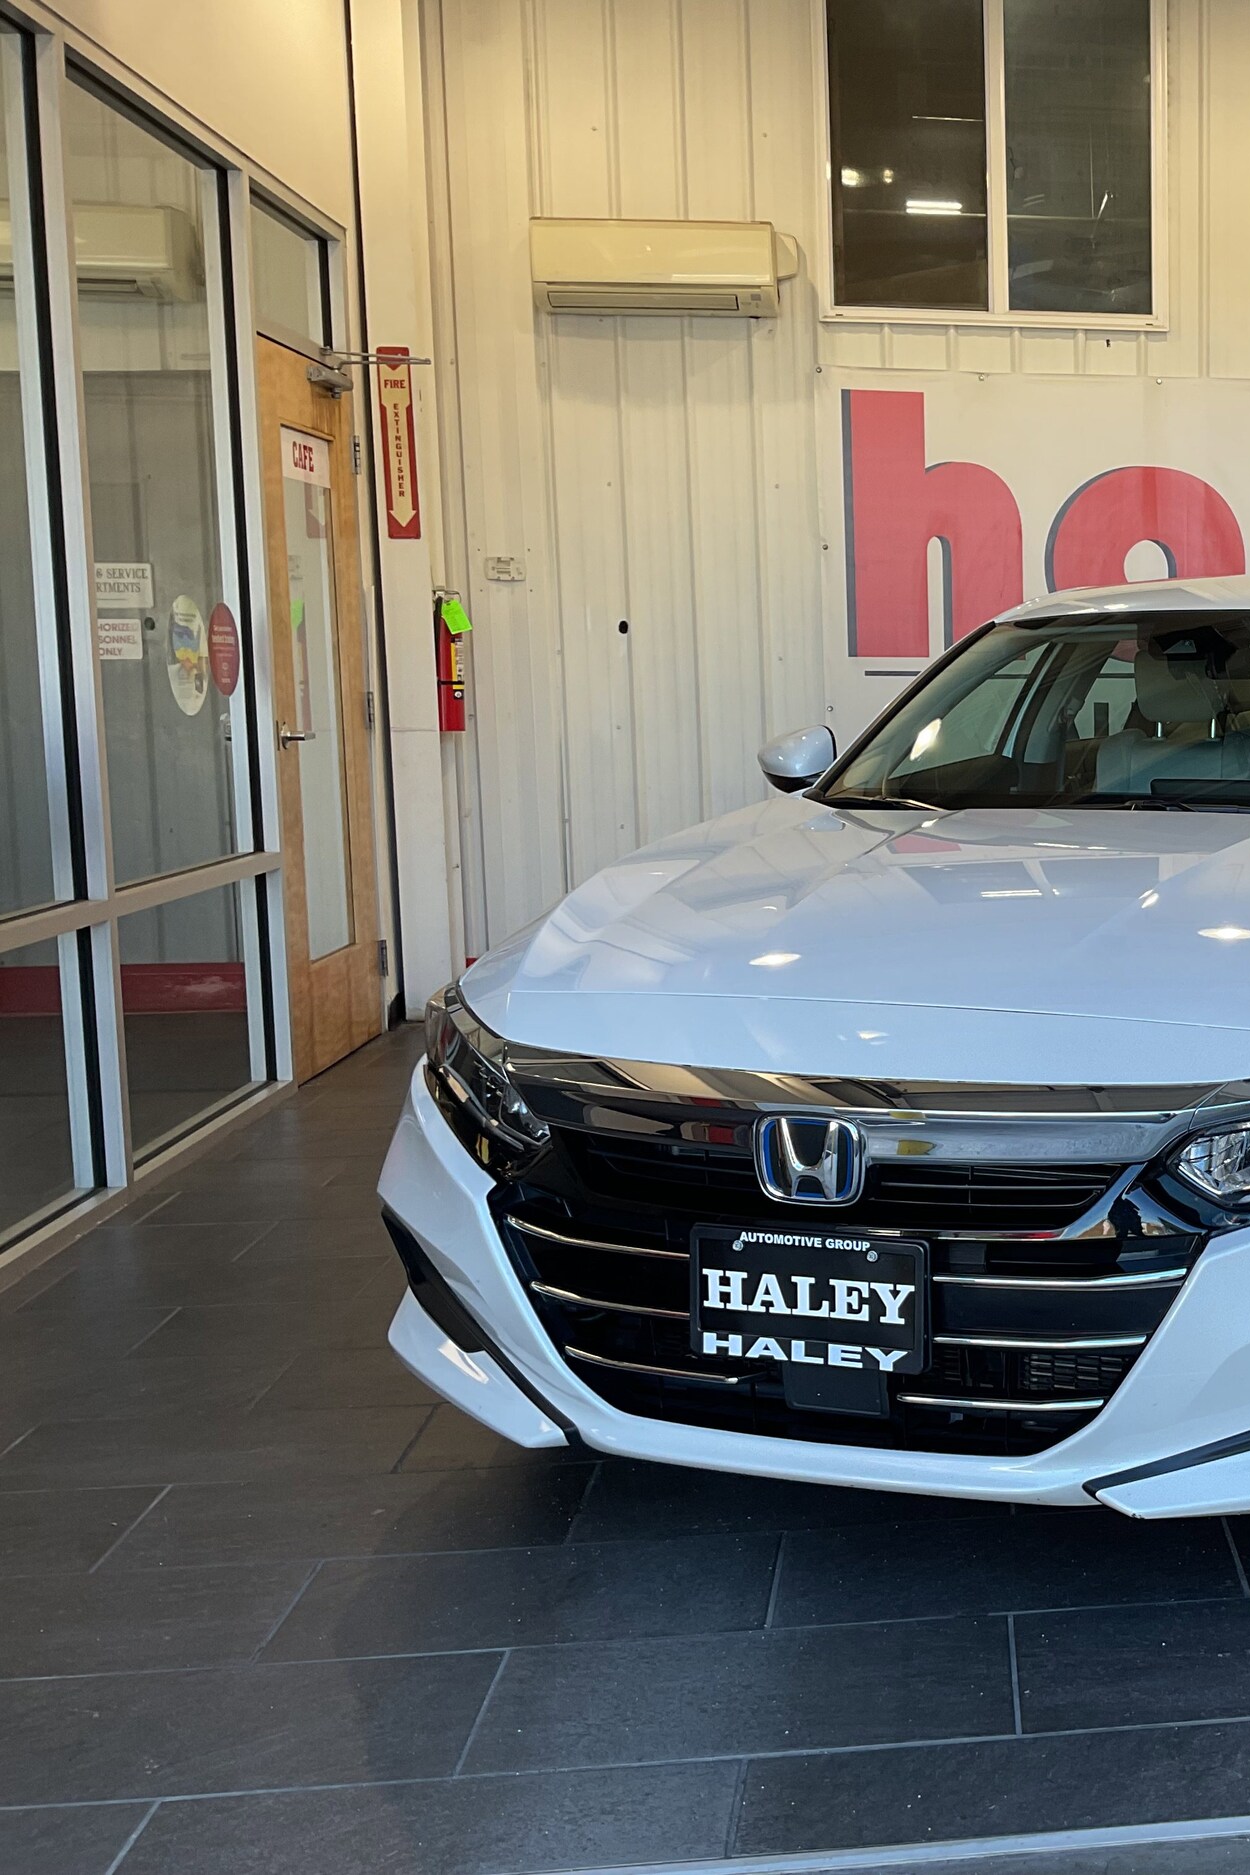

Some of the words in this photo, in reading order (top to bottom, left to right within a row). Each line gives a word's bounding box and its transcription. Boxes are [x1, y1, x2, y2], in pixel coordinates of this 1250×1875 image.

[384, 379, 406, 389] FIRE
[393, 403, 405, 497] EXTINGUISHER
[293, 441, 314, 472] CAFE
[107, 568, 148, 579] SERVICE
[96, 581, 141, 593] RTMENTS
[97, 623, 138, 632] HORIZED
[99, 635, 138, 645] SONNEL
[99, 648, 123, 656] ONLY
[740, 1231, 822, 1249] AUTOMOTIVE
[825, 1238, 871, 1252] GROUP
[702, 1268, 916, 1325] HALEY
[702, 1332, 908, 1372] HALEY
